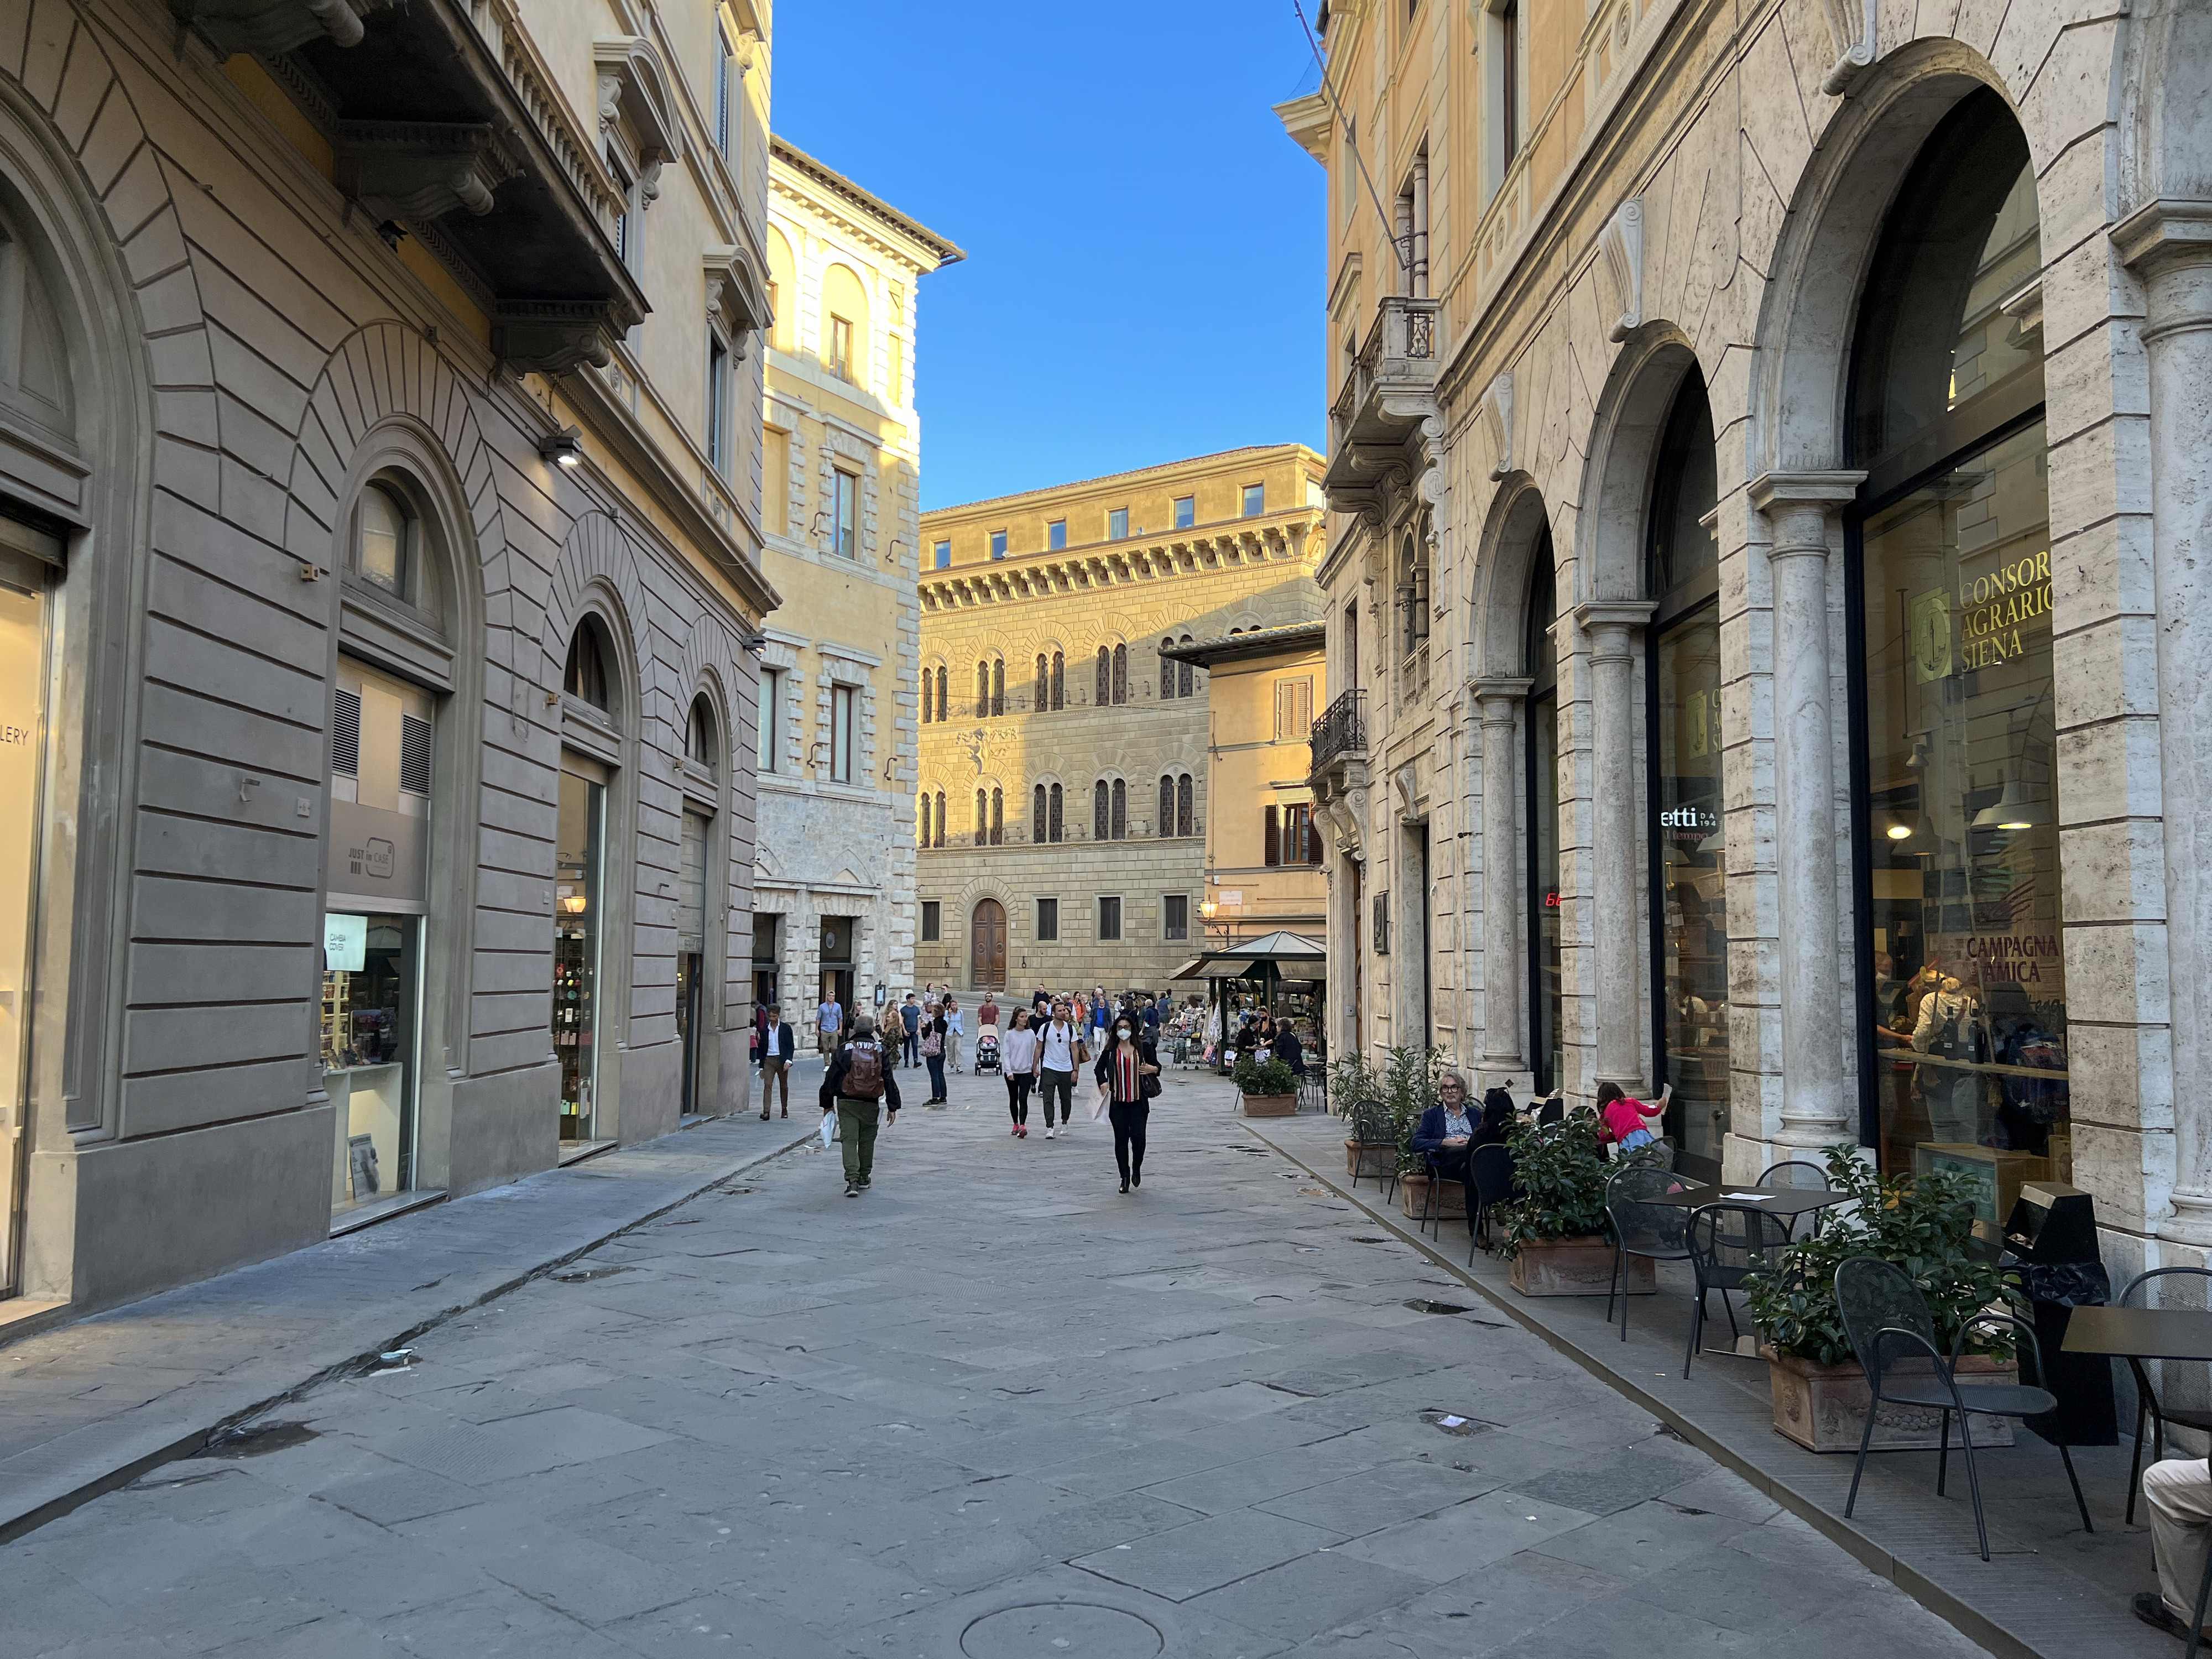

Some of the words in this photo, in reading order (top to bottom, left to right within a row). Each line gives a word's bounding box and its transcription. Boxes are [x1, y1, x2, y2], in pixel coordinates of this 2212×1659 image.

[1959, 551, 2052, 609] CONSOR
[1961, 629, 2023, 672] SIENA
[1, 725, 29, 746] LERY
[1661, 807, 1697, 826] etti
[348, 848, 364, 860] JUST
[366, 851, 372, 861] in
[1967, 935, 2059, 958] CAMPAGNA
[1984, 961, 2042, 983] AMICA
